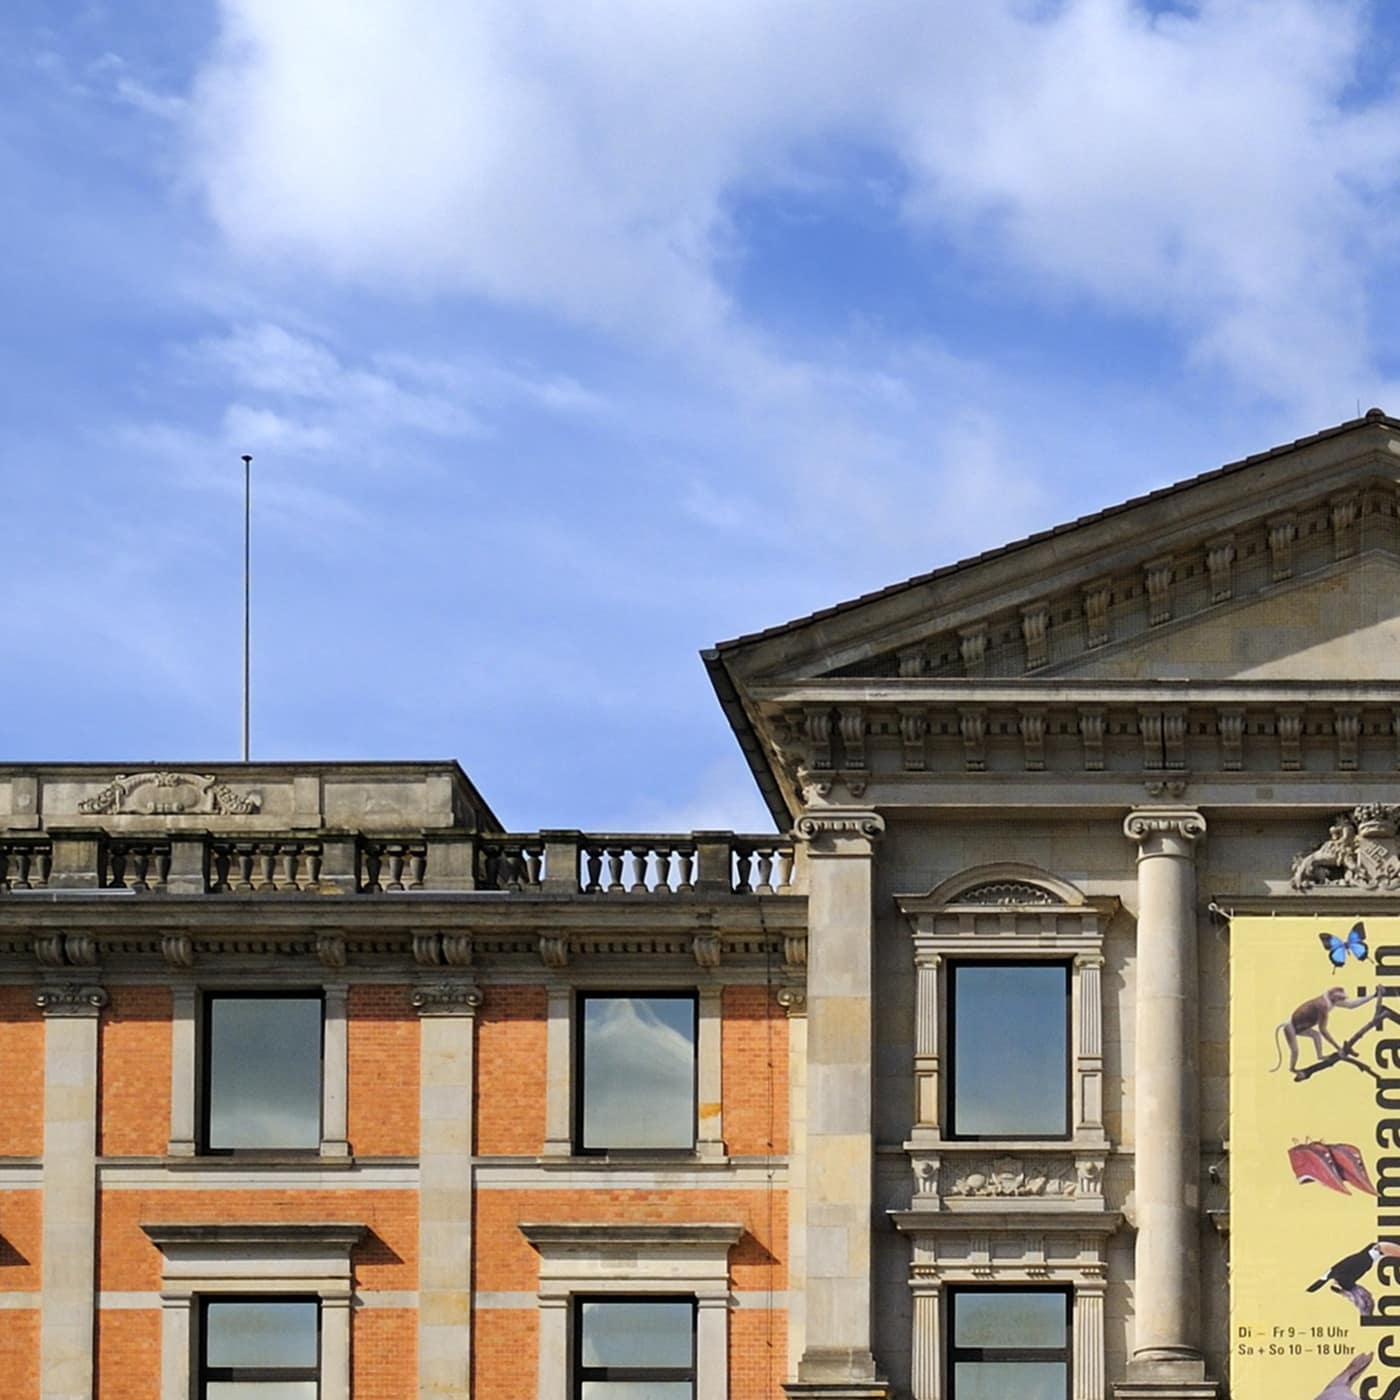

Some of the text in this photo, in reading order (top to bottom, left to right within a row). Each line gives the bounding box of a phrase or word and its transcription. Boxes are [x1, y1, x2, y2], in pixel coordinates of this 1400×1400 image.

[1238, 1326, 1252, 1338] Di
[1273, 1326, 1285, 1338] Fr
[1288, 1326, 1296, 1338] 9
[1311, 1326, 1324, 1338] 18
[1327, 1326, 1349, 1338] Uhr
[1238, 1343, 1254, 1355] Sa
[1268, 1343, 1285, 1355] So
[1289, 1343, 1302, 1355] 10
[1316, 1343, 1330, 1355] 18
[1333, 1343, 1355, 1355] Uhr
